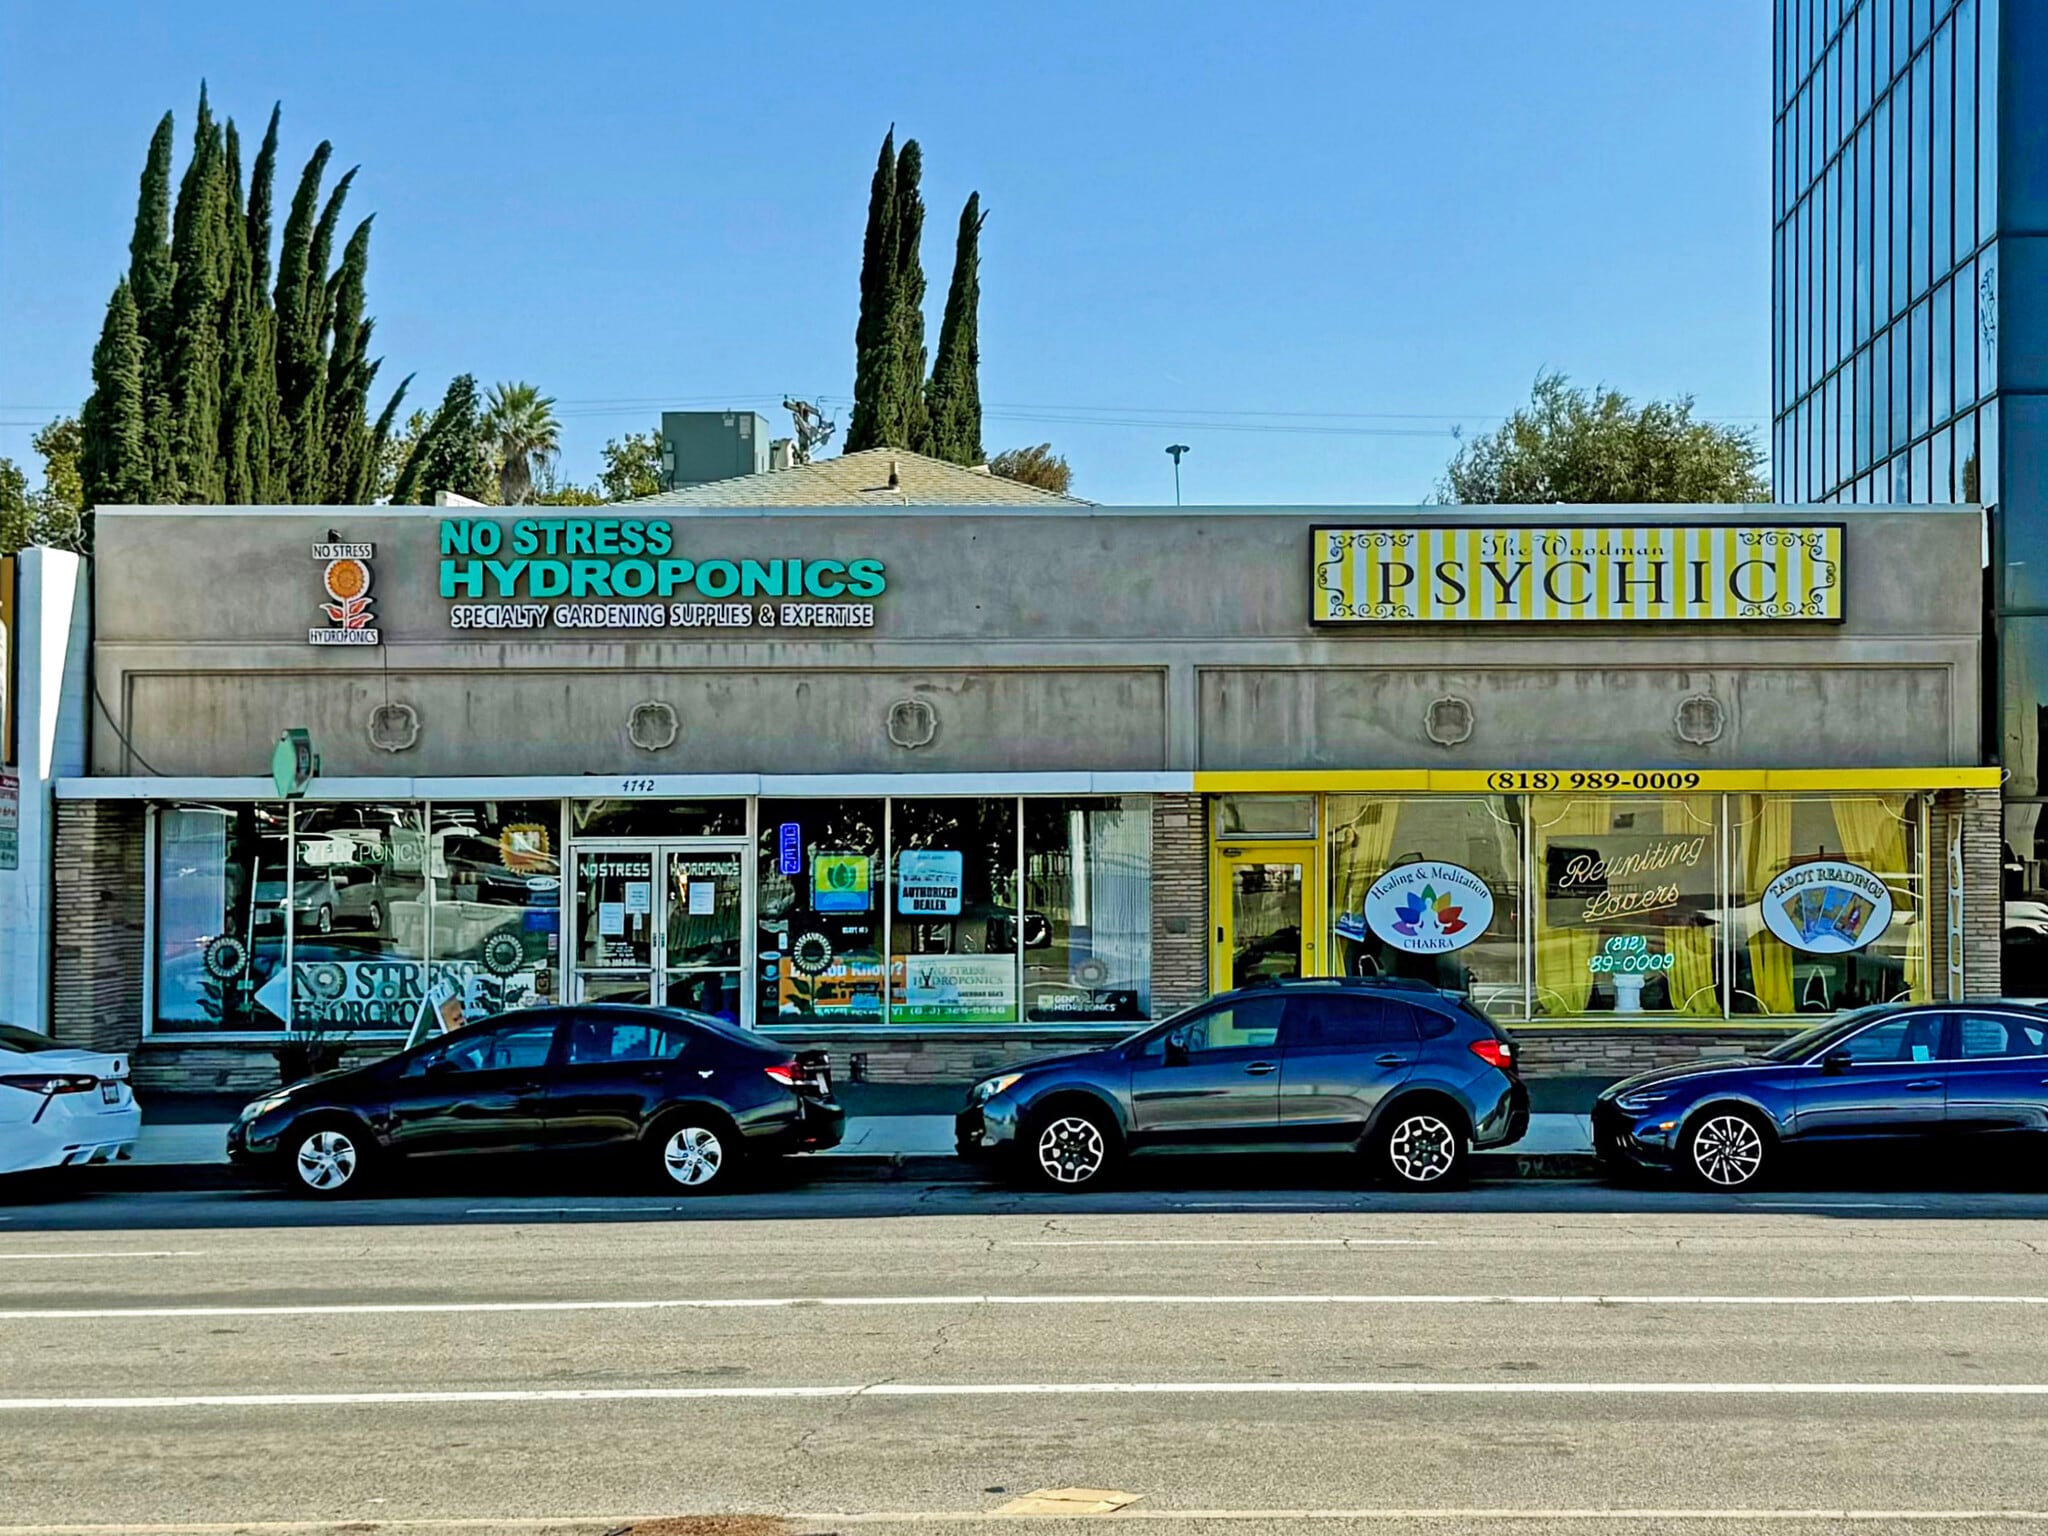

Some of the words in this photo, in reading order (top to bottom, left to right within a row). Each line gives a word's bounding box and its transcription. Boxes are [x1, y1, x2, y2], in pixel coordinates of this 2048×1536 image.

[440, 520, 501, 555] NO
[512, 520, 672, 556] STRESS
[1481, 535, 1527, 556] The
[1532, 534, 1665, 557] Woodman
[313, 545, 331, 558] NO
[333, 545, 371, 558] STRESS
[440, 559, 887, 600] HYDROPONICS
[1376, 559, 1779, 605] PSYCHIC
[451, 605, 548, 628] SPECIALTY
[553, 605, 665, 629] GARDENING
[670, 604, 753, 627] SUPPLIES
[759, 605, 775, 626] &
[780, 604, 874, 627] EXPERTISE
[310, 630, 377, 643] HYDROPONICS
[622, 779, 655, 792] 4742
[1487, 772, 1559, 791] (818)
[1570, 772, 1699, 789] 989-0009
[579, 863, 600, 877] NO
[600, 863, 650, 877] STRESS
[1558, 836, 1706, 888] Reuniting
[902, 886, 959, 899] AUTHORIZED
[1371, 871, 1414, 900] Healing
[1416, 867, 1428, 879] &
[1431, 866, 1489, 900] Meditation
[1769, 869, 1814, 899] TAROT
[1816, 868, 1886, 899] READINGS
[913, 900, 947, 911] DEALER
[1582, 883, 1680, 918] Lovers
[1403, 938, 1455, 949] CHAKRA
[1587, 953, 1675, 973] 89-0009
